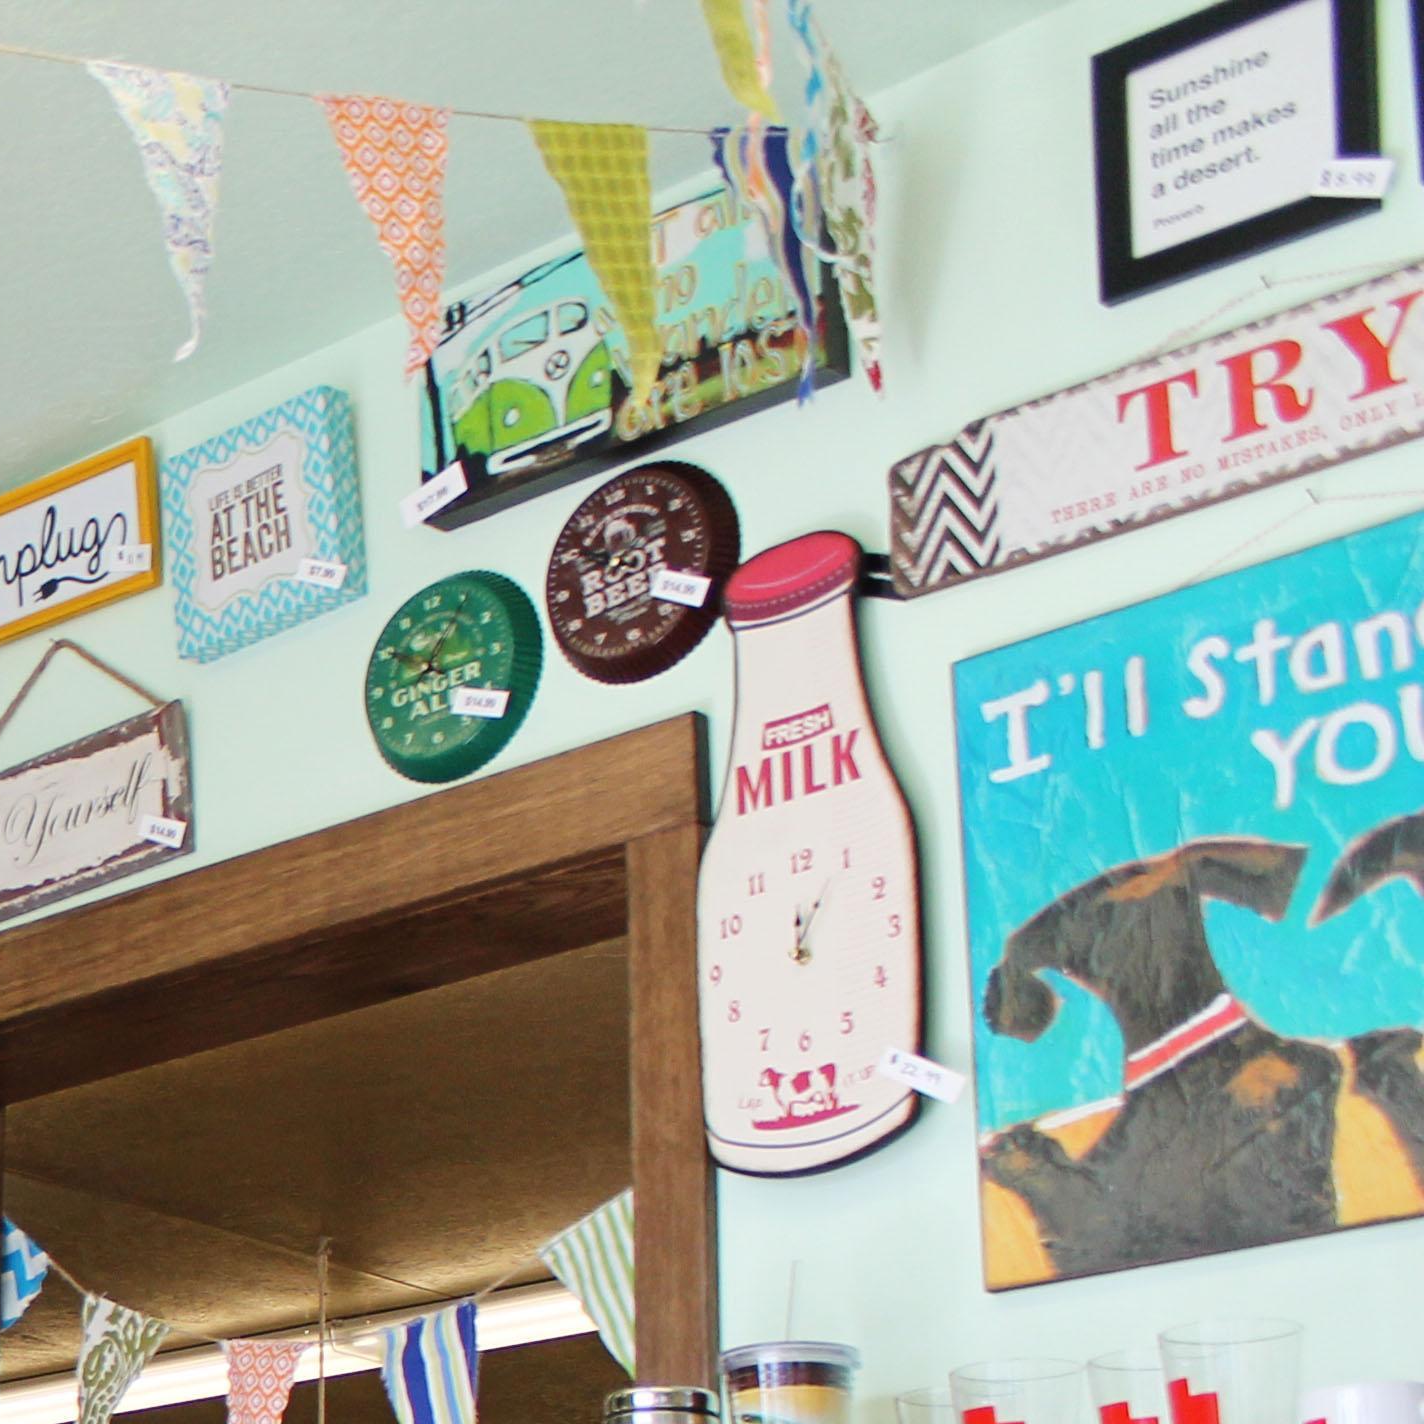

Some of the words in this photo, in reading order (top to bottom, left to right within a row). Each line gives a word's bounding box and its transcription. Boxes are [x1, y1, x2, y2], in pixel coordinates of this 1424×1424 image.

[1149, 50, 1270, 110] Sunshine
[1150, 114, 1178, 140] all
[1186, 97, 1227, 124] the
[1151, 137, 1205, 169] time
[1211, 101, 1298, 145] makes
[1151, 181, 1166, 199] a
[1174, 147, 1260, 191] desert.
[1116, 291, 1424, 472] TRY
[1051, 490, 1116, 525] THERE
[1129, 475, 1168, 502] ARE
[1180, 462, 1206, 486] NO
[1339, 398, 1398, 433] ONLY
[247, 464, 282, 496] BETTER
[211, 504, 236, 546] AT
[242, 480, 287, 529] THE
[211, 513, 292, 582] BEACH
[764, 710, 830, 746] FRESH
[981, 655, 1151, 784] I'll
[736, 728, 862, 817] MILK
[3, 752, 160, 866] Yourself
[790, 849, 812, 874] 12
[749, 873, 765, 896] 11
[872, 876, 886, 900] 2
[720, 915, 743, 940] 10
[888, 914, 901, 937] 3
[709, 964, 722, 987] 9
[728, 1000, 741, 1023] 8
[840, 1011, 853, 1034] 5
[759, 1028, 771, 1051] 7
[799, 1031, 811, 1052] 6
